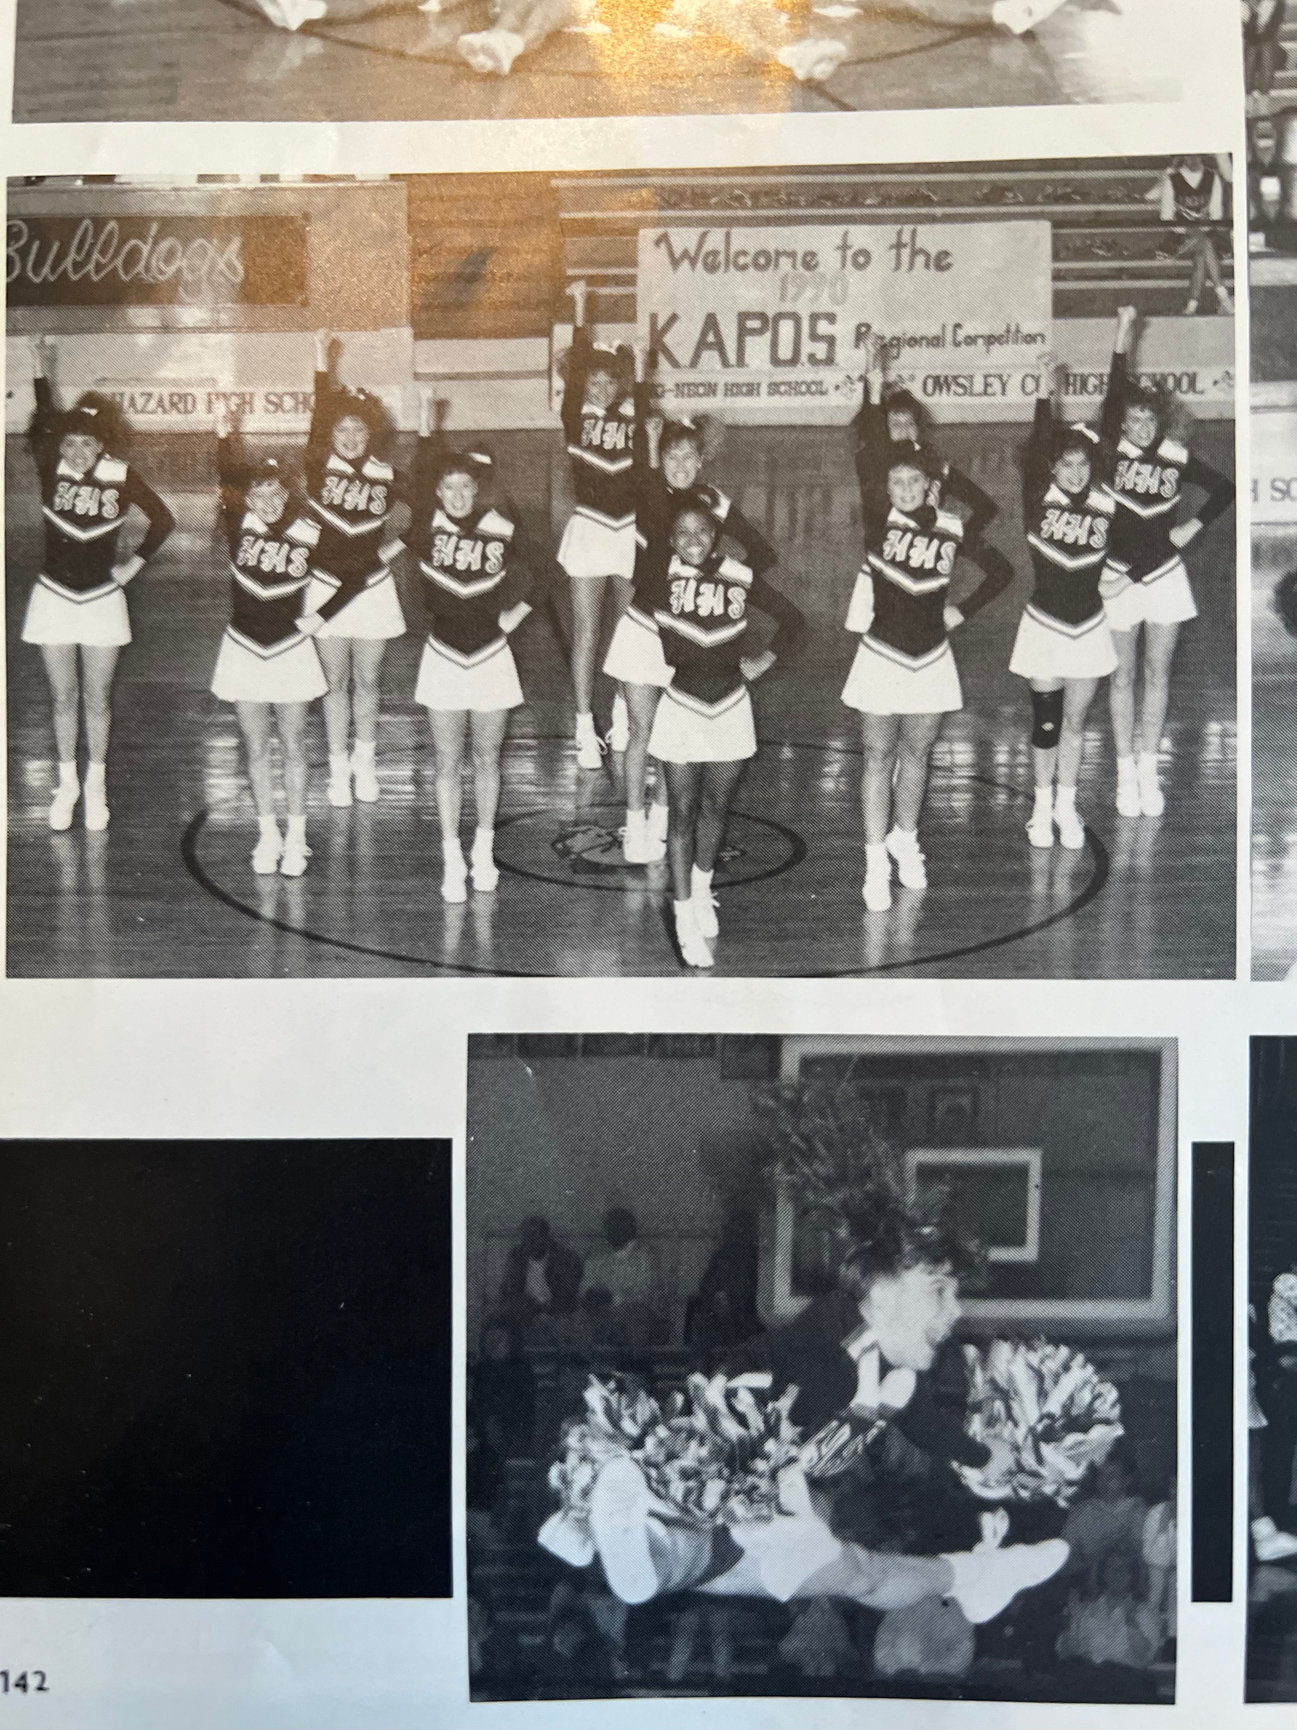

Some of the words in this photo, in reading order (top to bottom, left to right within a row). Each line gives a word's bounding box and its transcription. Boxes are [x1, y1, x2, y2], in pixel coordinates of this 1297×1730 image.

[7, 218, 244, 302] Bulldogs
[654, 229, 820, 274] Welcome
[834, 230, 872, 271] to
[889, 226, 953, 272] the
[779, 272, 850, 305] 1990
[650, 311, 837, 369] KAPOS
[922, 374, 1011, 397] OWSLEY
[0, 1669, 50, 1694] 142
